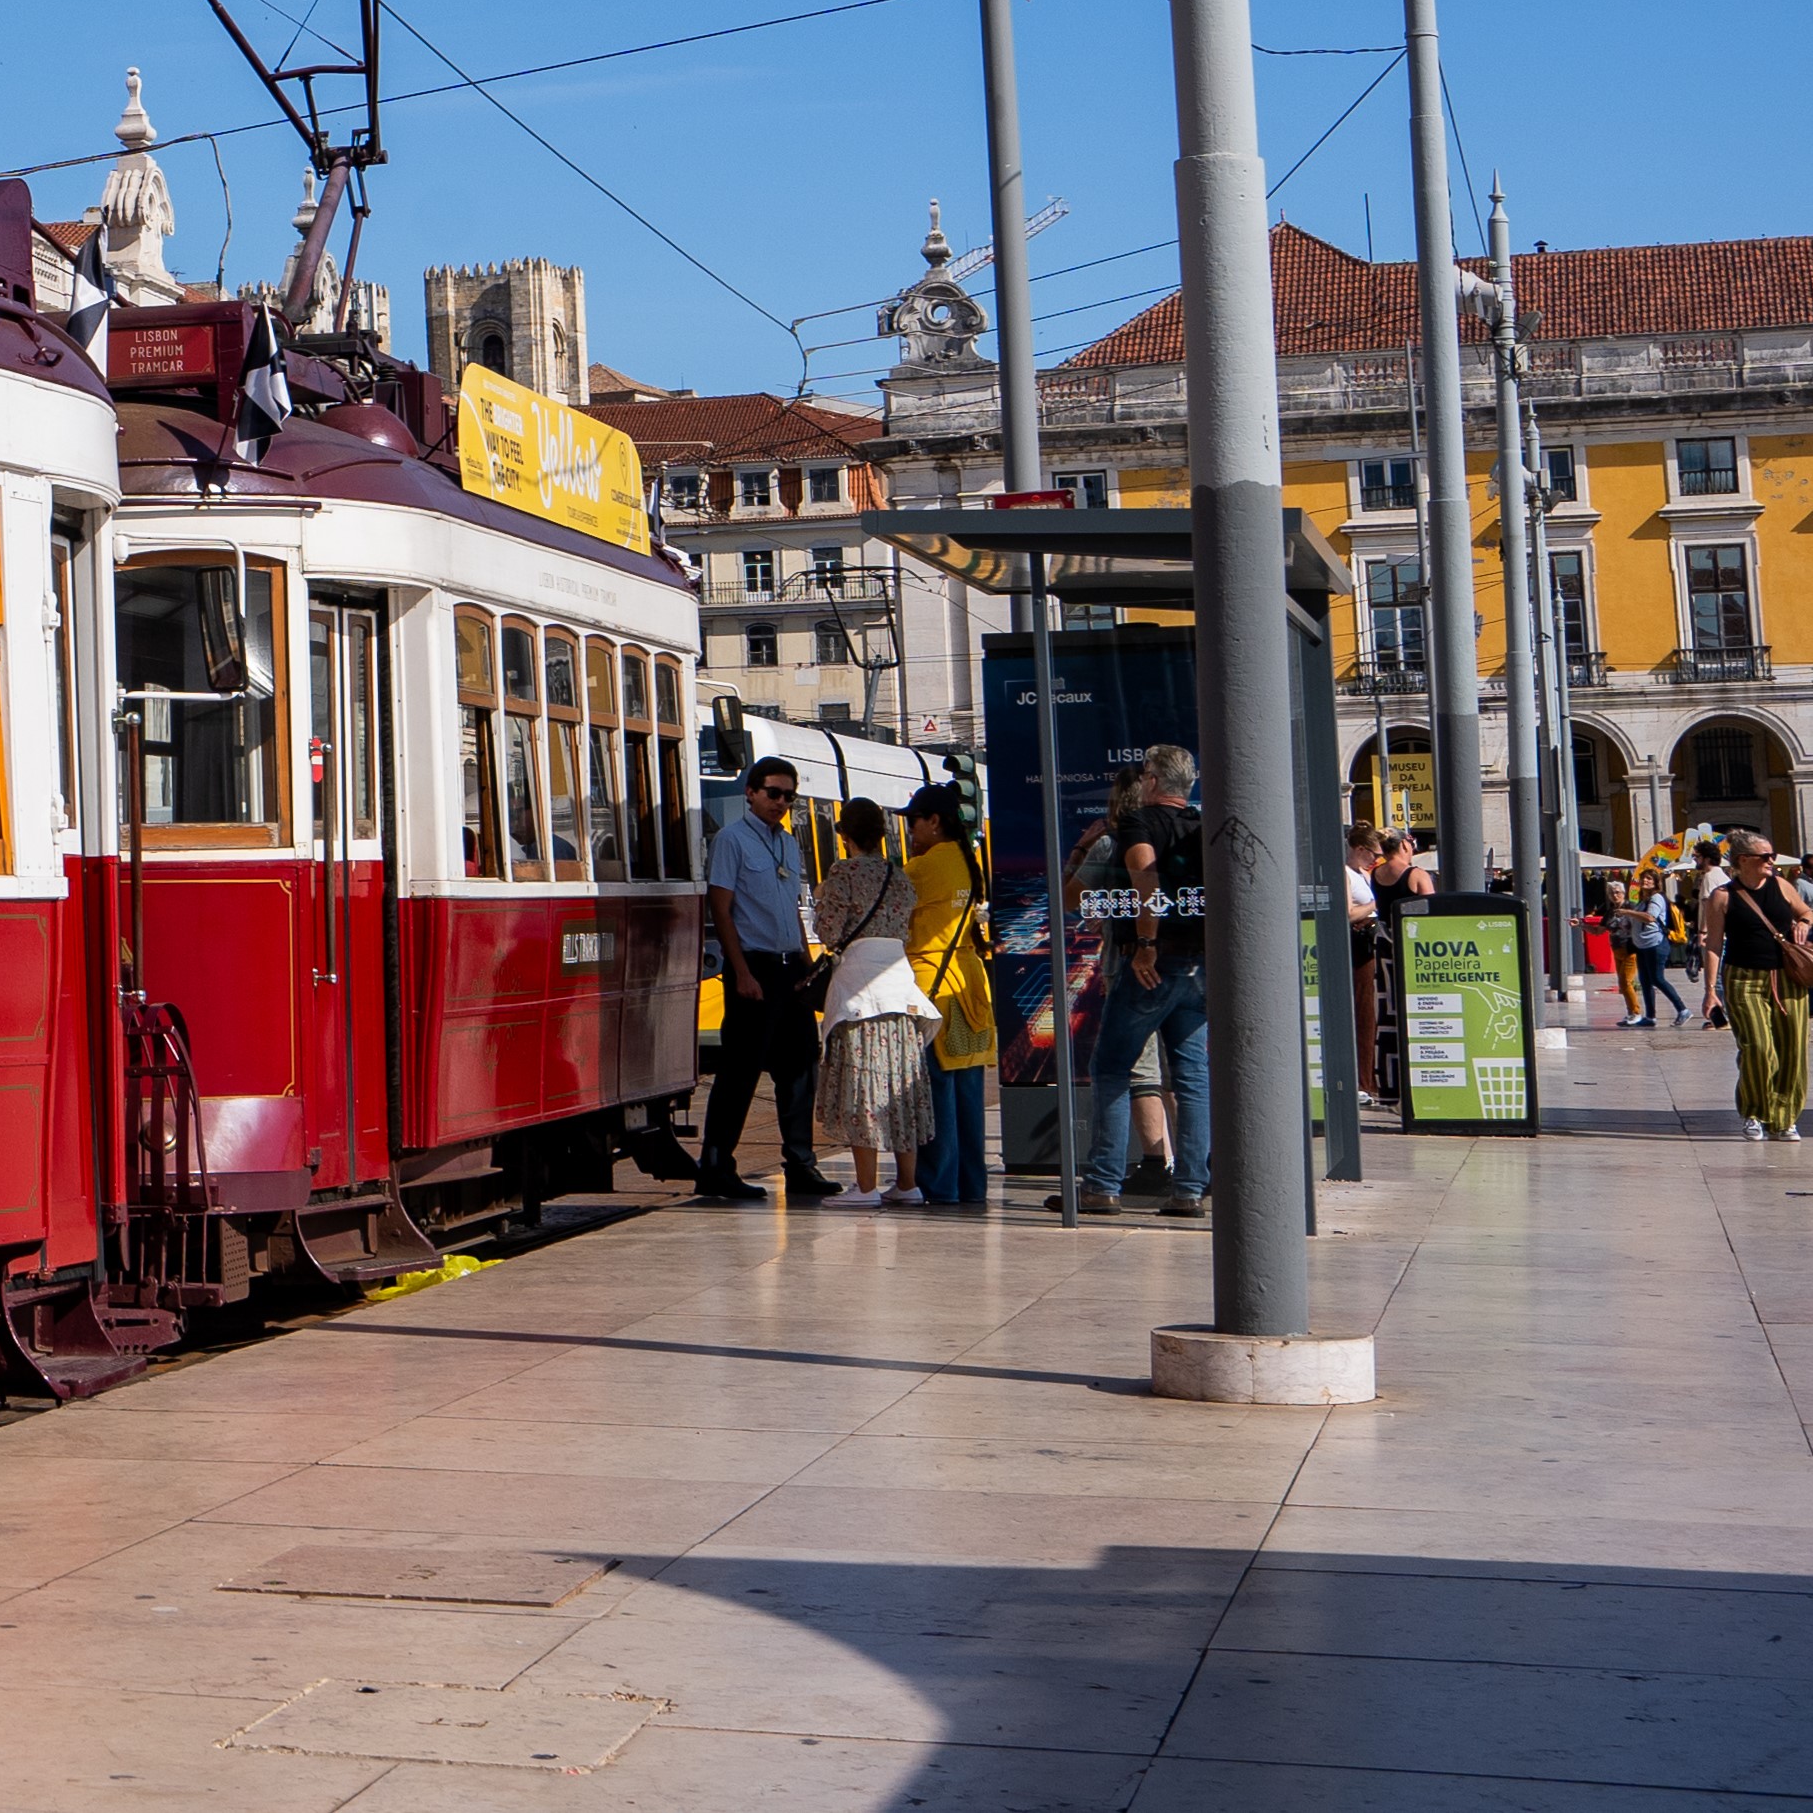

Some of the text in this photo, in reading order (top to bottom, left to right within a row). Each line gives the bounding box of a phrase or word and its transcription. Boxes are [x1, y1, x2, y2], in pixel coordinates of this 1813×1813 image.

[135, 330, 178, 343] LISBON
[130, 345, 183, 358] PREMIUM
[131, 360, 183, 374] TRAMCAR
[531, 402, 602, 509] Yellow
[1016, 691, 1092, 705] JCecaux
[1388, 762, 1425, 772] MUSEU
[1390, 783, 1432, 792] ERVEJA
[1396, 802, 1423, 811] BER
[1414, 941, 1479, 958] NOVA
[1415, 958, 1481, 974] Papeleira
[1415, 971, 1500, 983] INTELIGENTE
